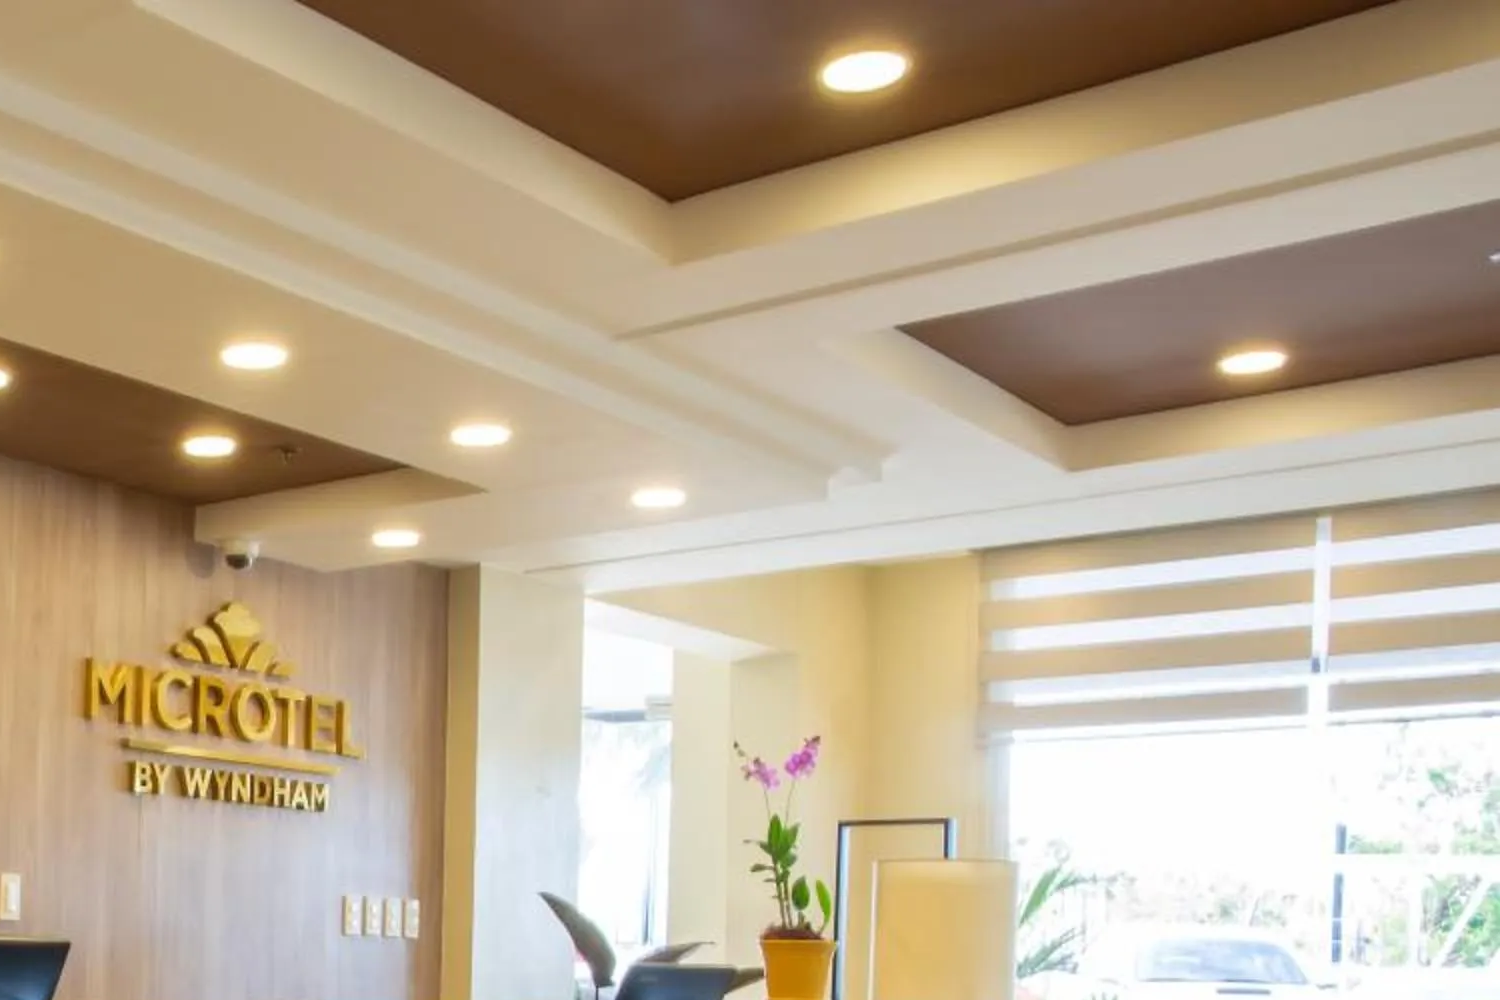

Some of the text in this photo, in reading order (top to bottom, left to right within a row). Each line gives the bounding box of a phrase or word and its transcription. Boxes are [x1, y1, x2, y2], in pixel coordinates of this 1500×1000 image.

[84, 657, 364, 760] MICROTEL
[129, 760, 330, 812] BY WYNDHAM
